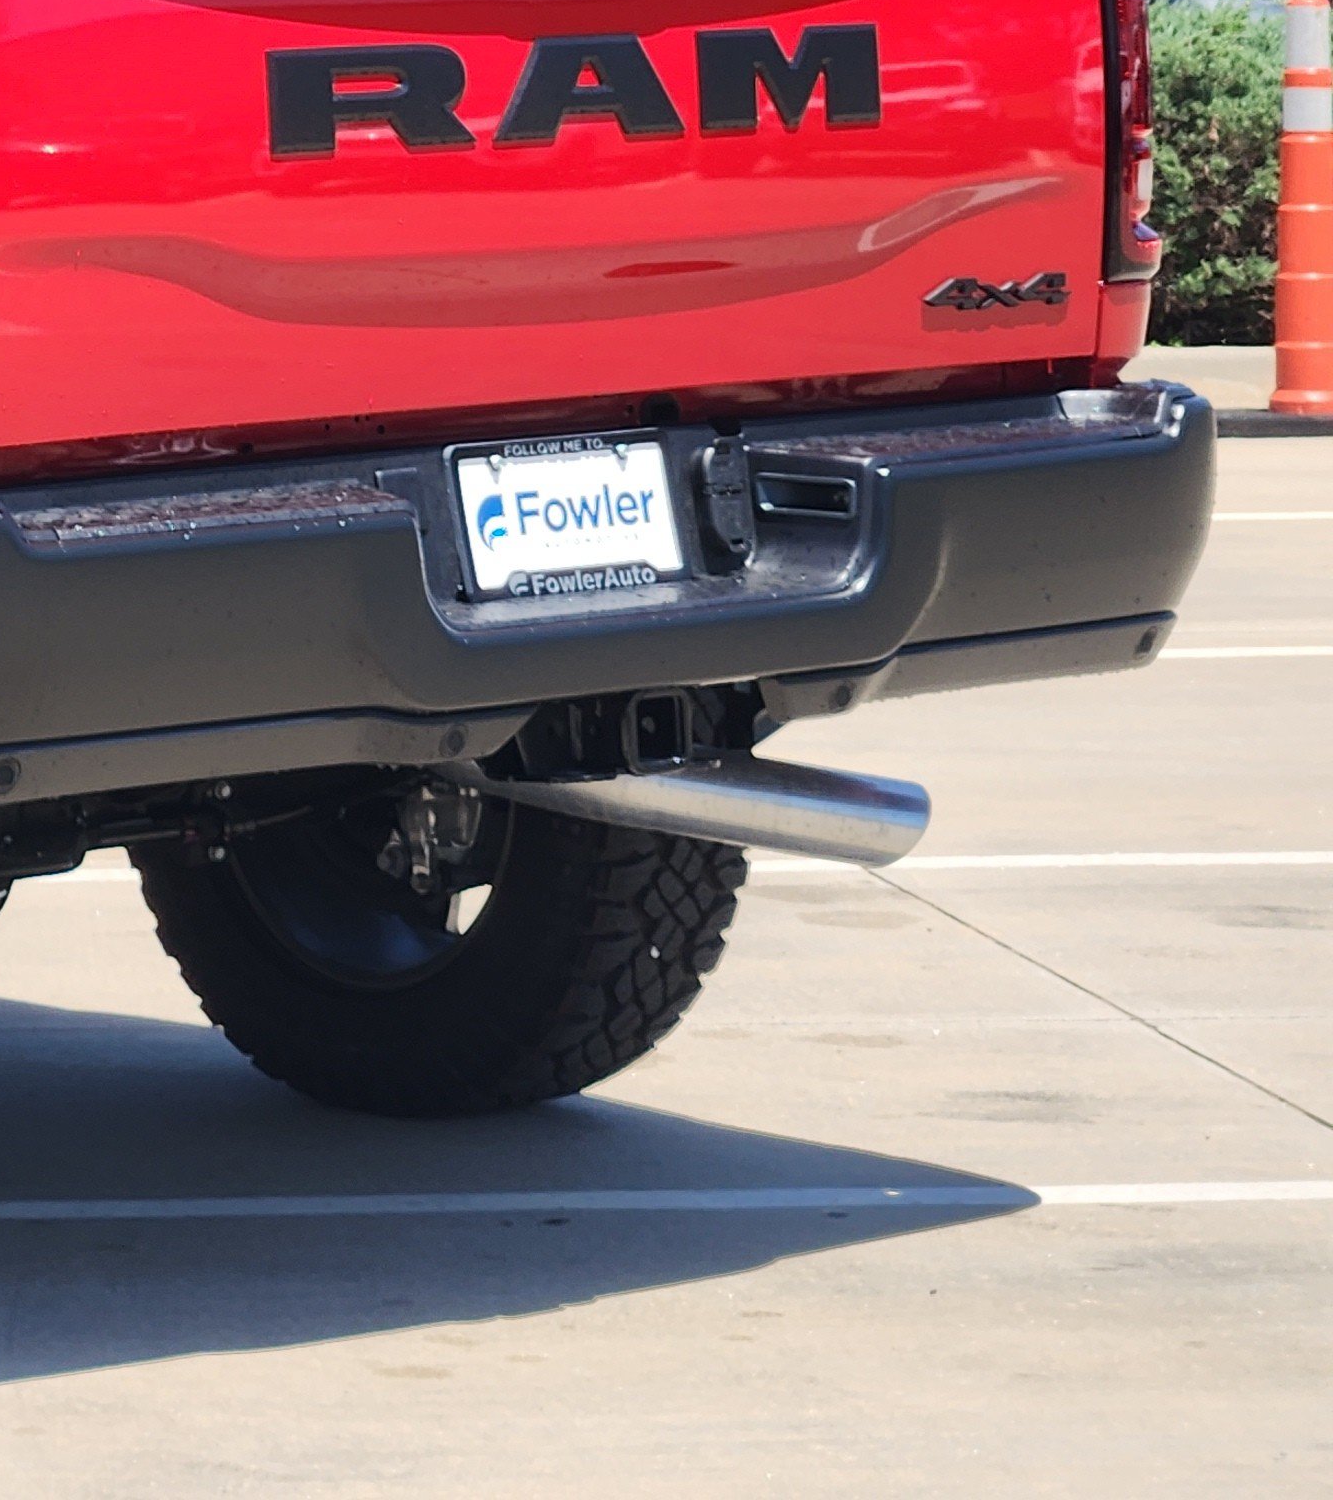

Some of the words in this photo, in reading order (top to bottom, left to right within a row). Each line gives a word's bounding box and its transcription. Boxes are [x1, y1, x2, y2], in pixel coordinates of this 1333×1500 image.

[265, 24, 880, 162] RAM
[504, 442, 561, 457] FOLLOW
[563, 439, 582, 453] ME
[515, 484, 654, 535] Fowler
[532, 565, 656, 595] FowlerAuto
